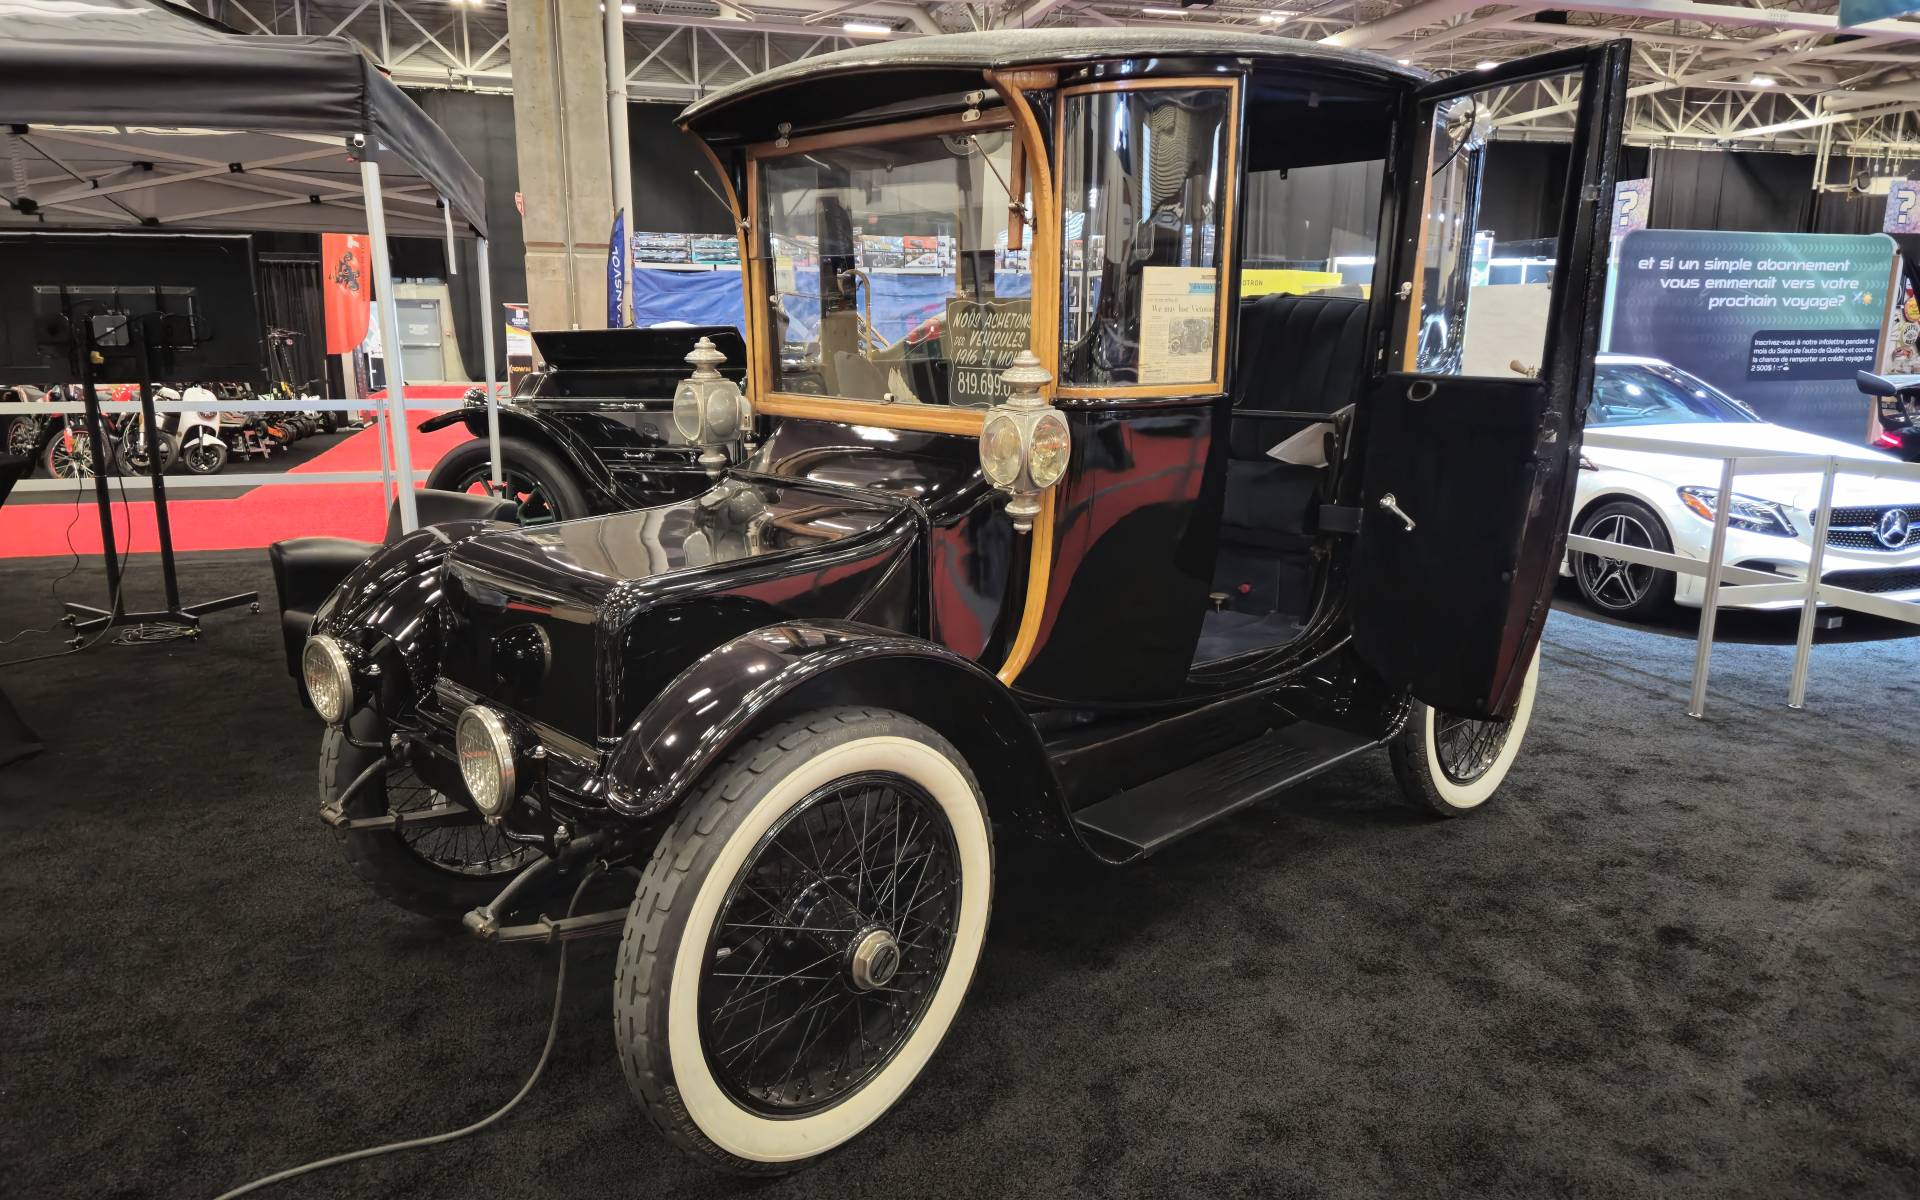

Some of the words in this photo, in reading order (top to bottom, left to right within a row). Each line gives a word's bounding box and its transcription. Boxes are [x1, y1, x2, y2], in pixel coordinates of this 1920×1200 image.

[1638, 257, 1655, 270] et
[1659, 256, 1674, 270] si
[1678, 258, 1700, 270] un
[1703, 257, 1752, 273] simple
[1756, 258, 1851, 272] abonnement
[1660, 278, 1700, 289] vous
[1704, 276, 1777, 289] emmenait
[1782, 278, 1815, 289] vers
[1820, 277, 1859, 289] votre
[1708, 294, 1777, 310] prochain
[1782, 295, 1846, 310] voyage?
[953, 312, 980, 328] NOUS
[1845, 338, 1869, 346] pendant
[955, 348, 978, 364] 1916
[981, 349, 996, 366] ET
[1753, 347, 1768, 355] mois
[1818, 346, 1826, 354] de
[1780, 355, 1789, 363] de
[1789, 356, 1818, 364] remporter
[1845, 355, 1865, 363] voyage
